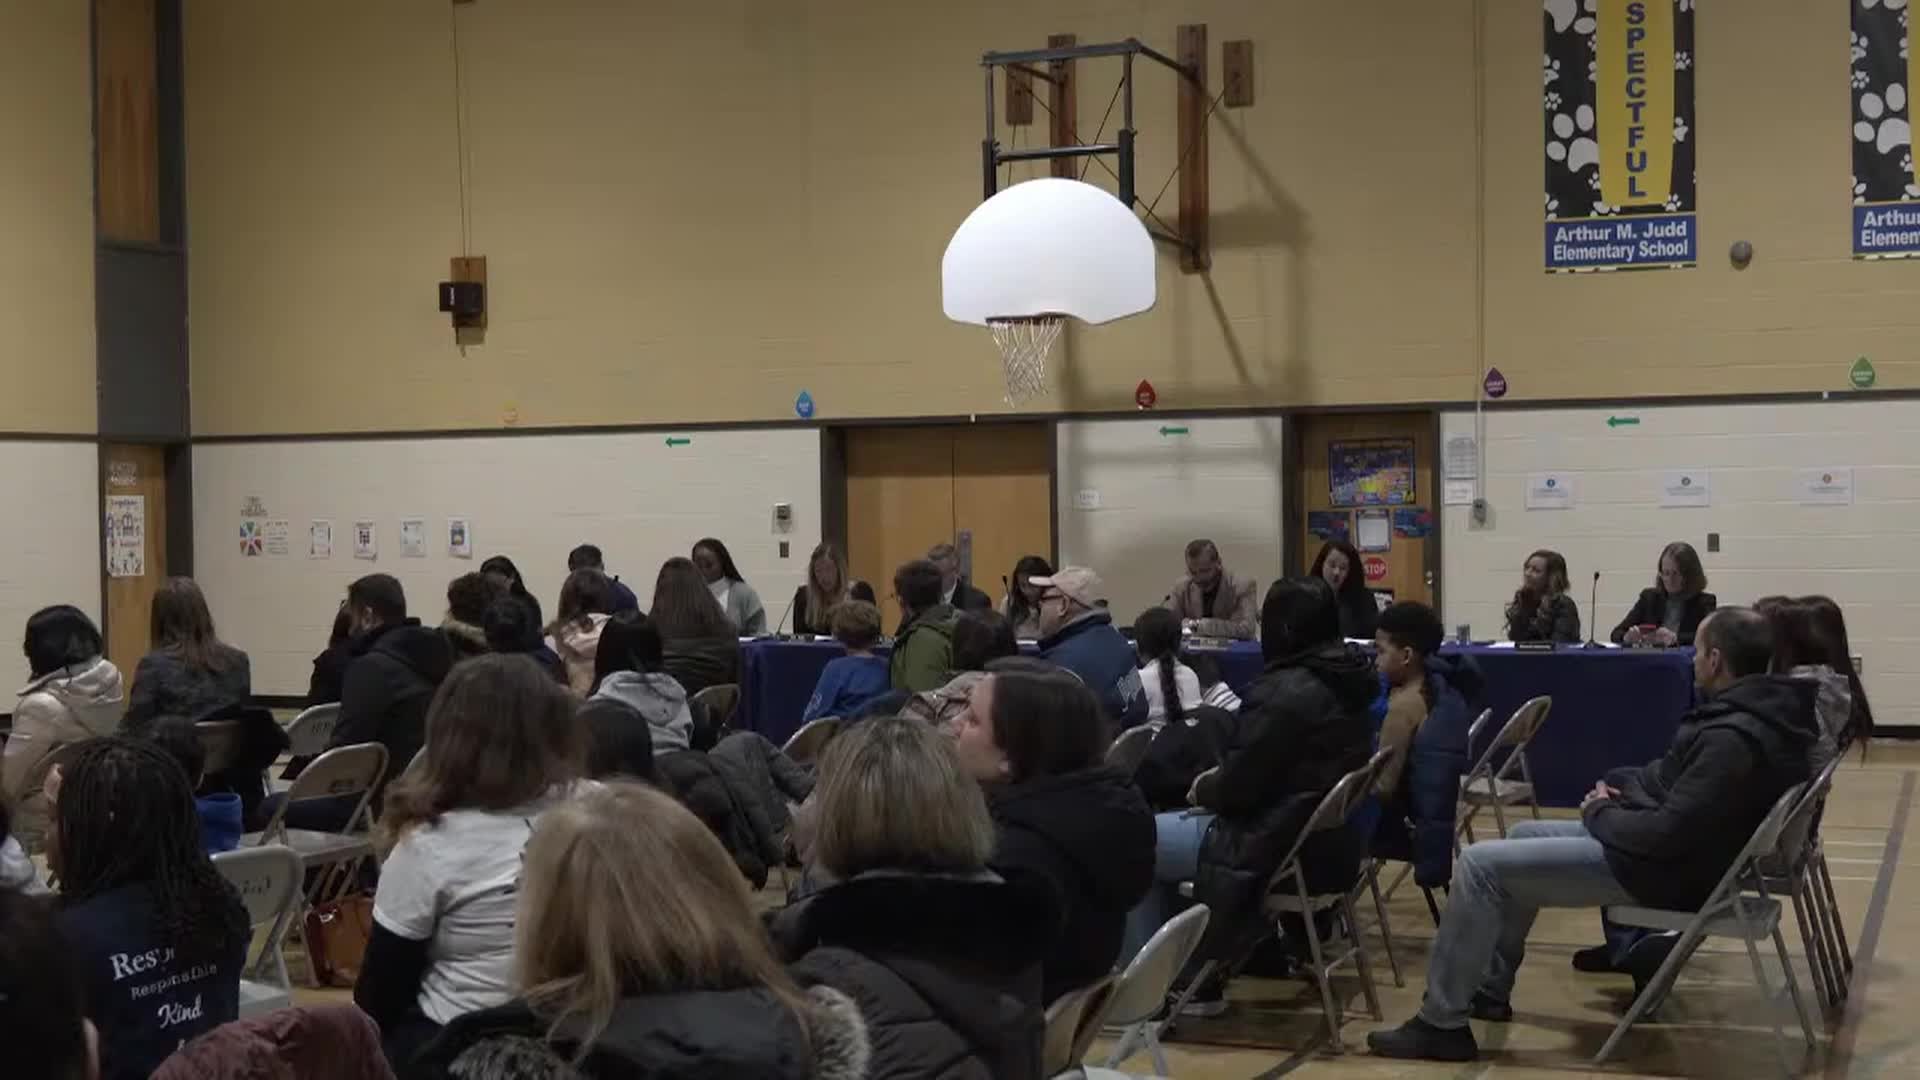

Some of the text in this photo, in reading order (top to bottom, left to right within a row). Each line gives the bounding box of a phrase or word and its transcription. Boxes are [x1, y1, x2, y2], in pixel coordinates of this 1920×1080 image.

[1626, 2, 1648, 199] SPECTFUL
[1555, 221, 1687, 242] Arthur M. Judd
[1861, 229, 1920, 247] Elemen
[1553, 239, 1689, 262] Elementary School
[1364, 563, 1385, 575] STOP
[157, 993, 204, 1029] Kind
